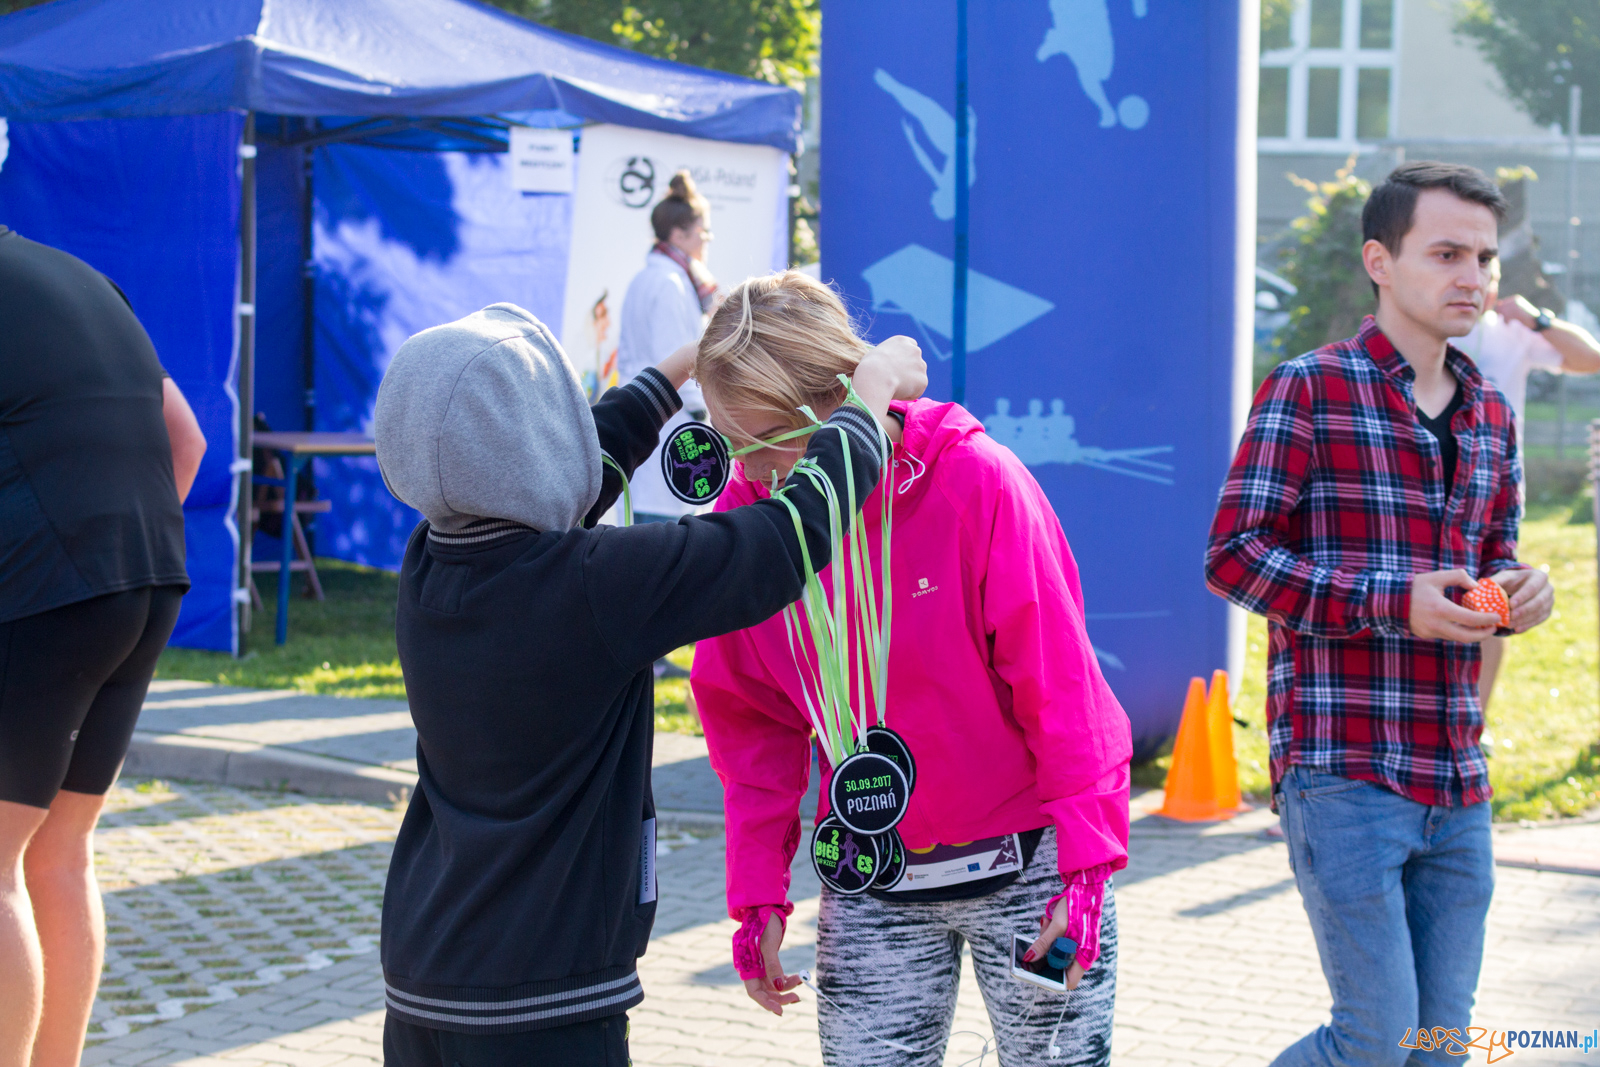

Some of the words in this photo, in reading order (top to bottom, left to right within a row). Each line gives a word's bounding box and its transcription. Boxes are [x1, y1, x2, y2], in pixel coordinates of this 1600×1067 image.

[679, 430, 699, 460] BIEG
[698, 442, 711, 454] 2
[694, 477, 710, 497] ES
[844, 775, 891, 793] 30.09.2017
[847, 788, 896, 815] POZNAŃ
[831, 829, 839, 845] 2
[815, 840, 839, 861] BIEG
[857, 854, 873, 874] ES
